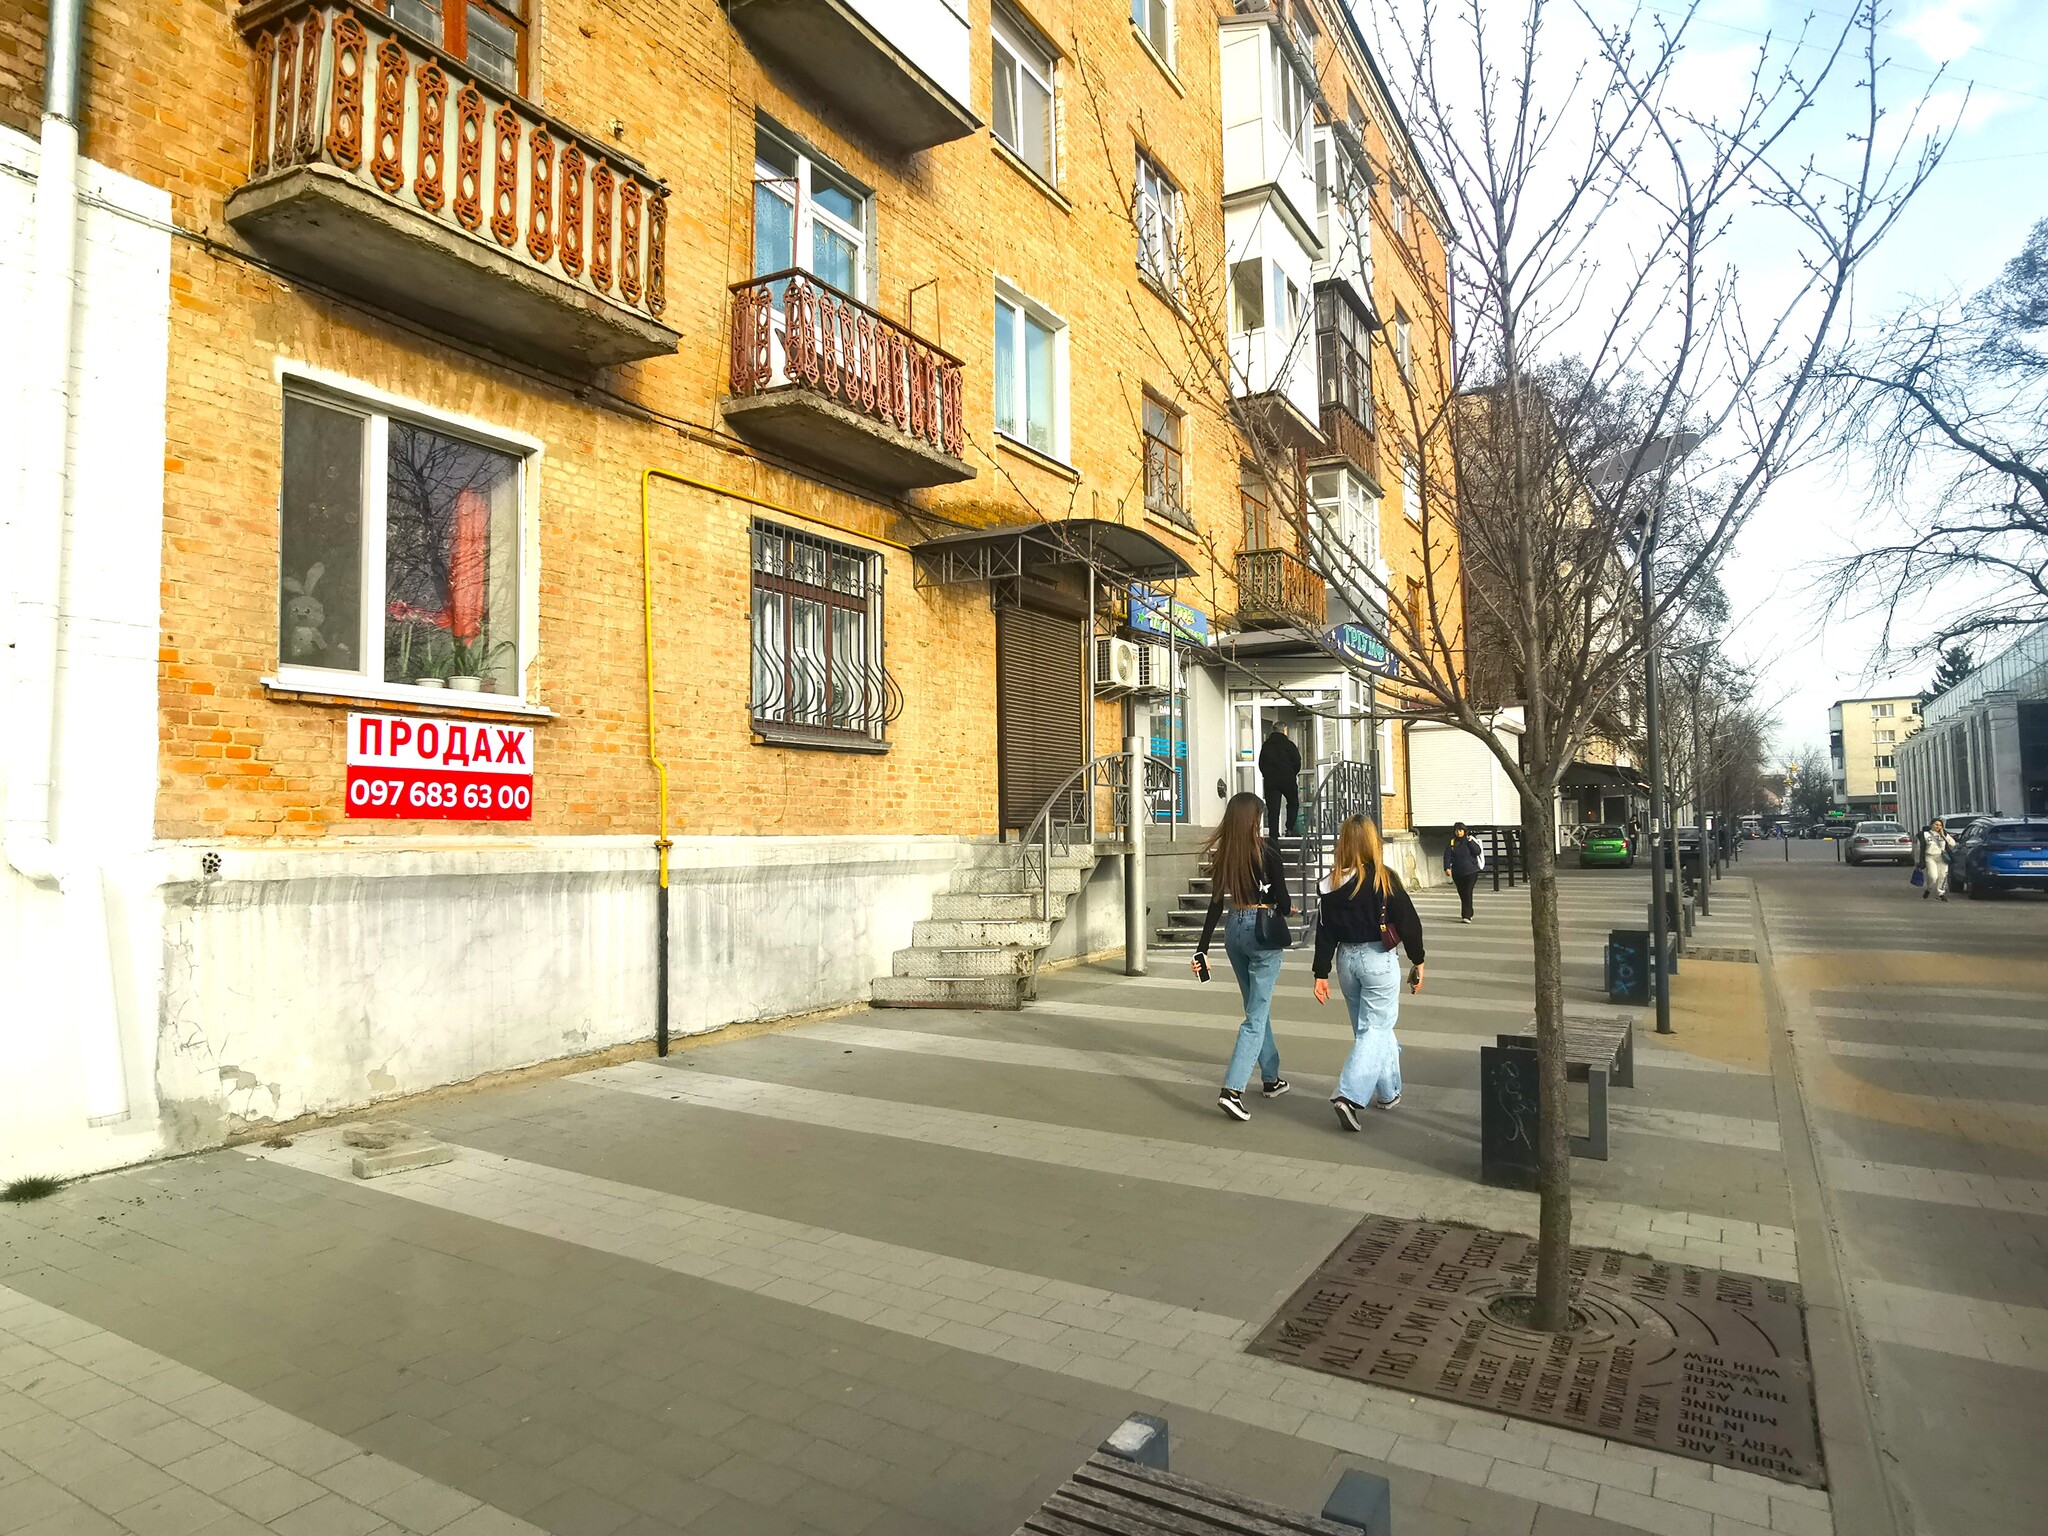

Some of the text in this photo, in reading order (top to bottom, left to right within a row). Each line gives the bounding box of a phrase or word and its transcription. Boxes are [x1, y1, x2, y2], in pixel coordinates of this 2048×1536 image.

[359, 717, 526, 767] ПРОДАЖ
[350, 778, 530, 810] 097 683 63 00
[1400, 1311, 1439, 1333] MY
[1390, 1332, 1428, 1347] IS
[1319, 1345, 1363, 1370] ALL
[1369, 1349, 1418, 1379] THIS
[1734, 1361, 1780, 1378] WITH
[1683, 1362, 1759, 1385] WASHED
[1681, 1385, 1729, 1402] AS IF
[1682, 1374, 1788, 1404] THEY WERE
[1679, 1409, 1745, 1433] IN THE
[1681, 1395, 1777, 1427] MORNING
[1677, 1423, 1793, 1459] VERY GOOD
[1675, 1436, 1802, 1476] PEOPLE ARE
